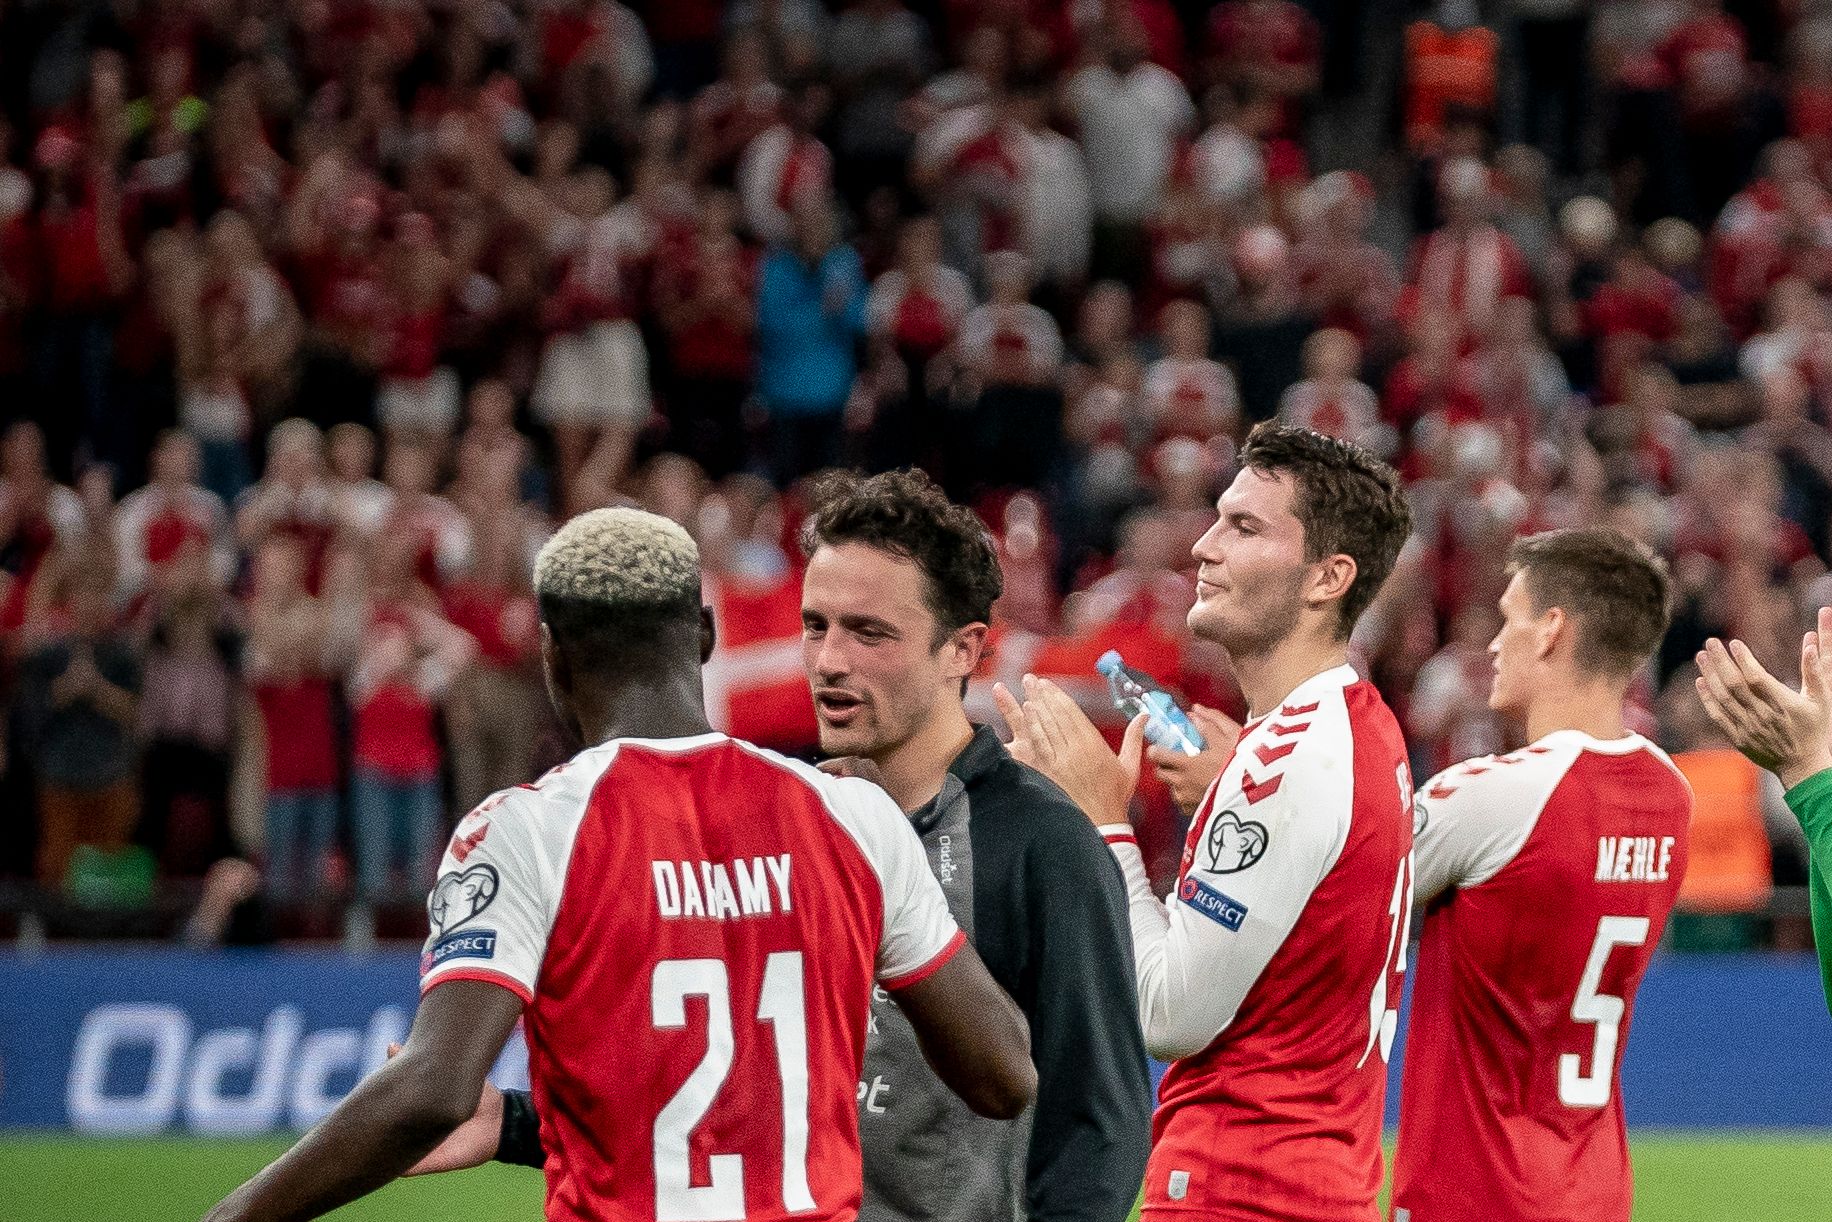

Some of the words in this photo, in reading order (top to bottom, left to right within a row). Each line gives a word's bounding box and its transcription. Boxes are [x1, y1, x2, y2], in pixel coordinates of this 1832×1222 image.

[1593, 836, 1676, 881] MÆHLE
[1193, 889, 1245, 924] RESPECT
[1558, 916, 1650, 1108] 5
